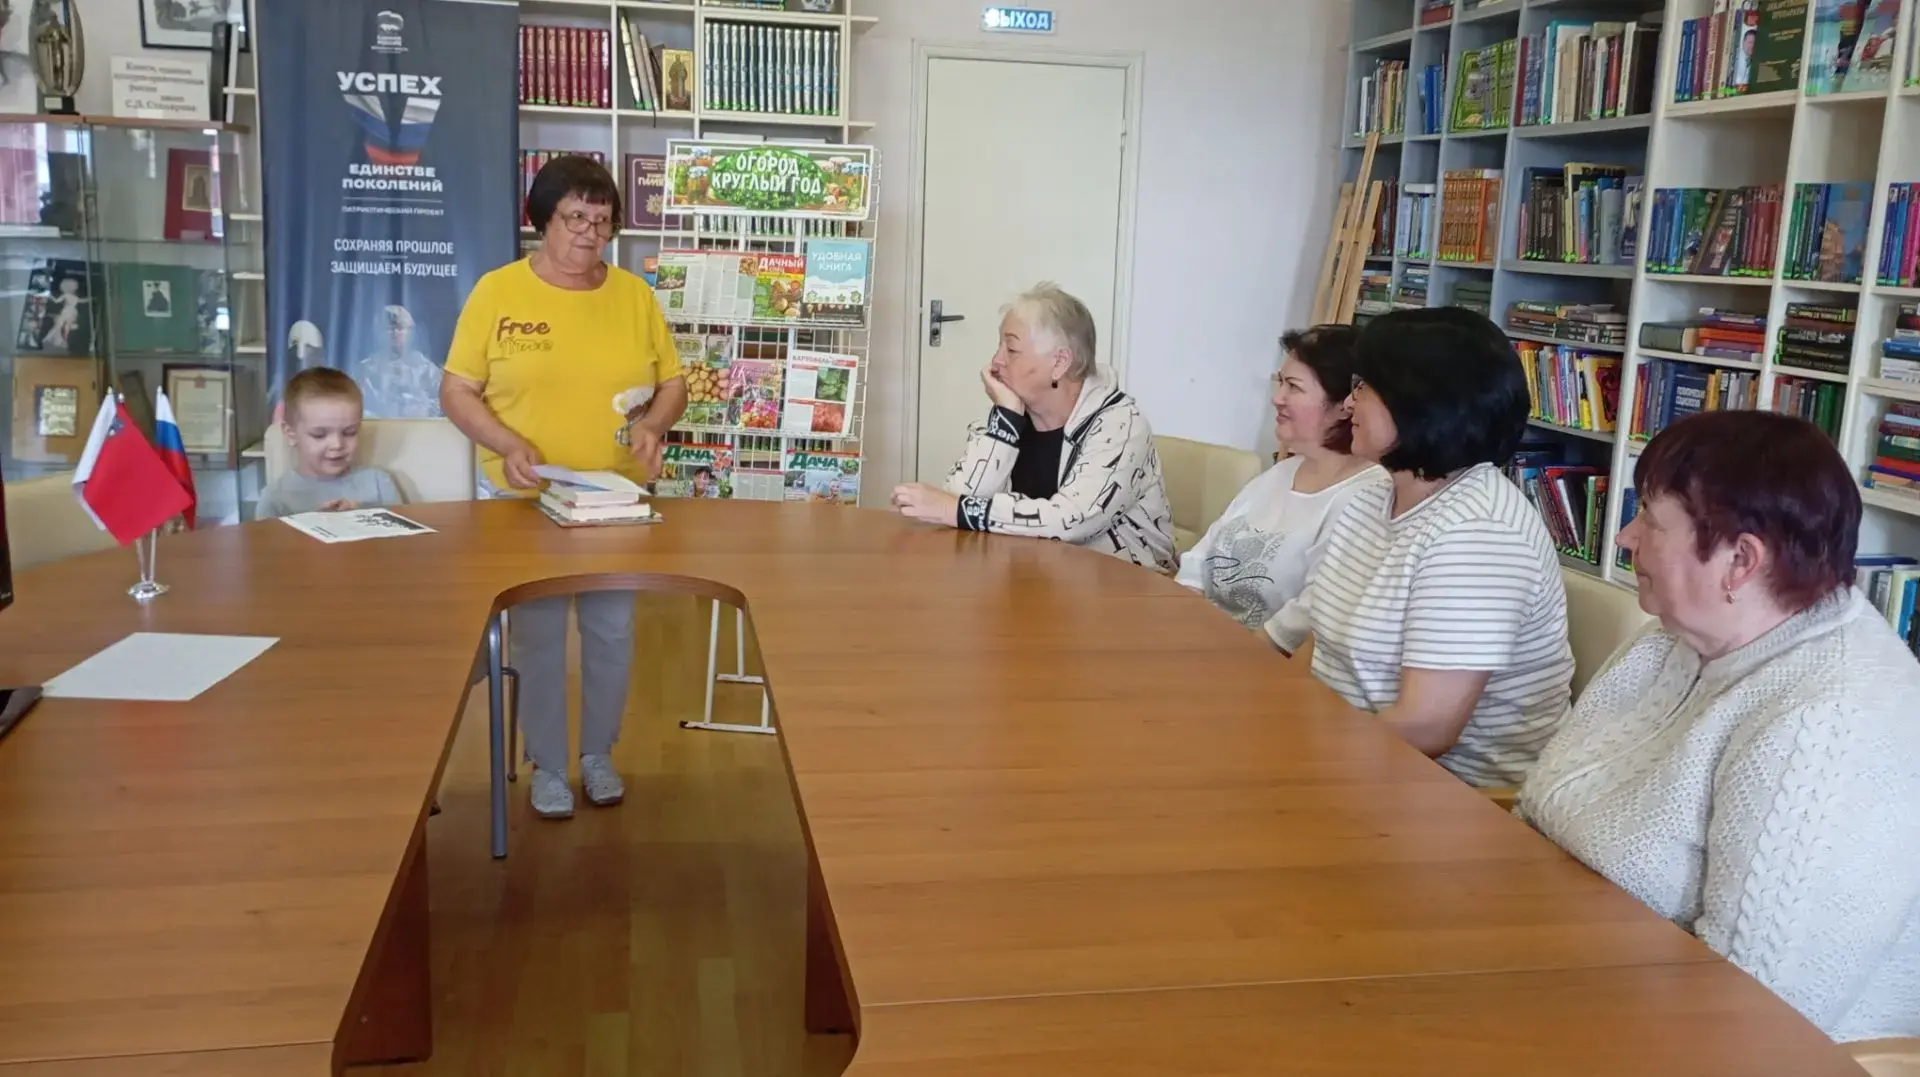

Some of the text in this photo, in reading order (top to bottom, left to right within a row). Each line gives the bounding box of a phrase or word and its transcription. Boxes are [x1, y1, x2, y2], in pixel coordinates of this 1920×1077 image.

[336, 71, 443, 96] УСПЕХ
[349, 163, 436, 178] ЕДИНСТВЕ
[735, 152, 799, 178] ОГОРОД
[342, 178, 443, 193] ПОКОЛЕНИЙ
[711, 170, 821, 196] КРУГЛЫЙ ГОД
[333, 238, 454, 255] СОХРАНЯЯ ПРОШЛОЕ
[811, 251, 862, 262] УДОБНАЯ
[330, 260, 458, 277] ЗАЩИЩАЕМ БУДУЩЕЕ
[818, 262, 852, 273] КНИГА
[497, 316, 551, 341] Free
